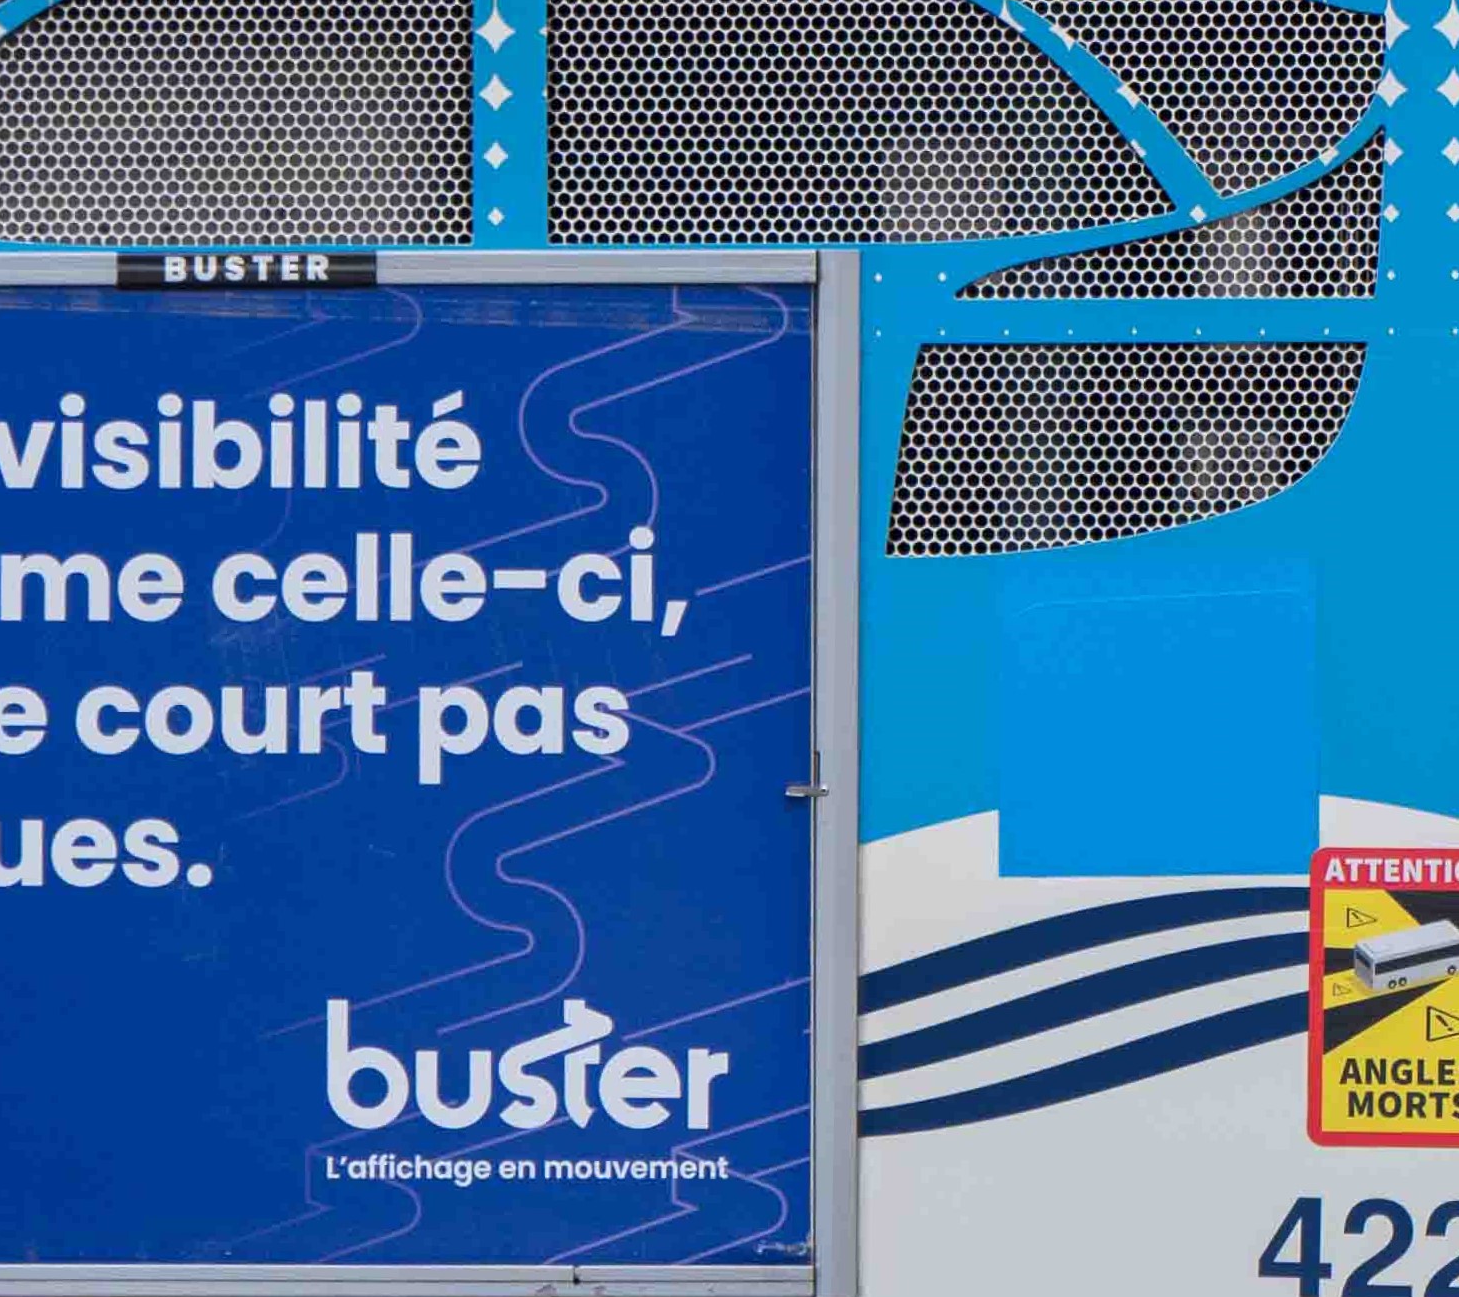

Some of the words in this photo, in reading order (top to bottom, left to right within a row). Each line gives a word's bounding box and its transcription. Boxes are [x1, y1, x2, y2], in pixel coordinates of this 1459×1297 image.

[164, 254, 330, 283] BUSTER
[212, 527, 690, 637] celle-ci,
[75, 670, 387, 755] court
[419, 685, 631, 785] pas
[327, 999, 729, 1130] buster
[498, 1159, 537, 1180] en
[544, 1156, 729, 1180] mouvement
